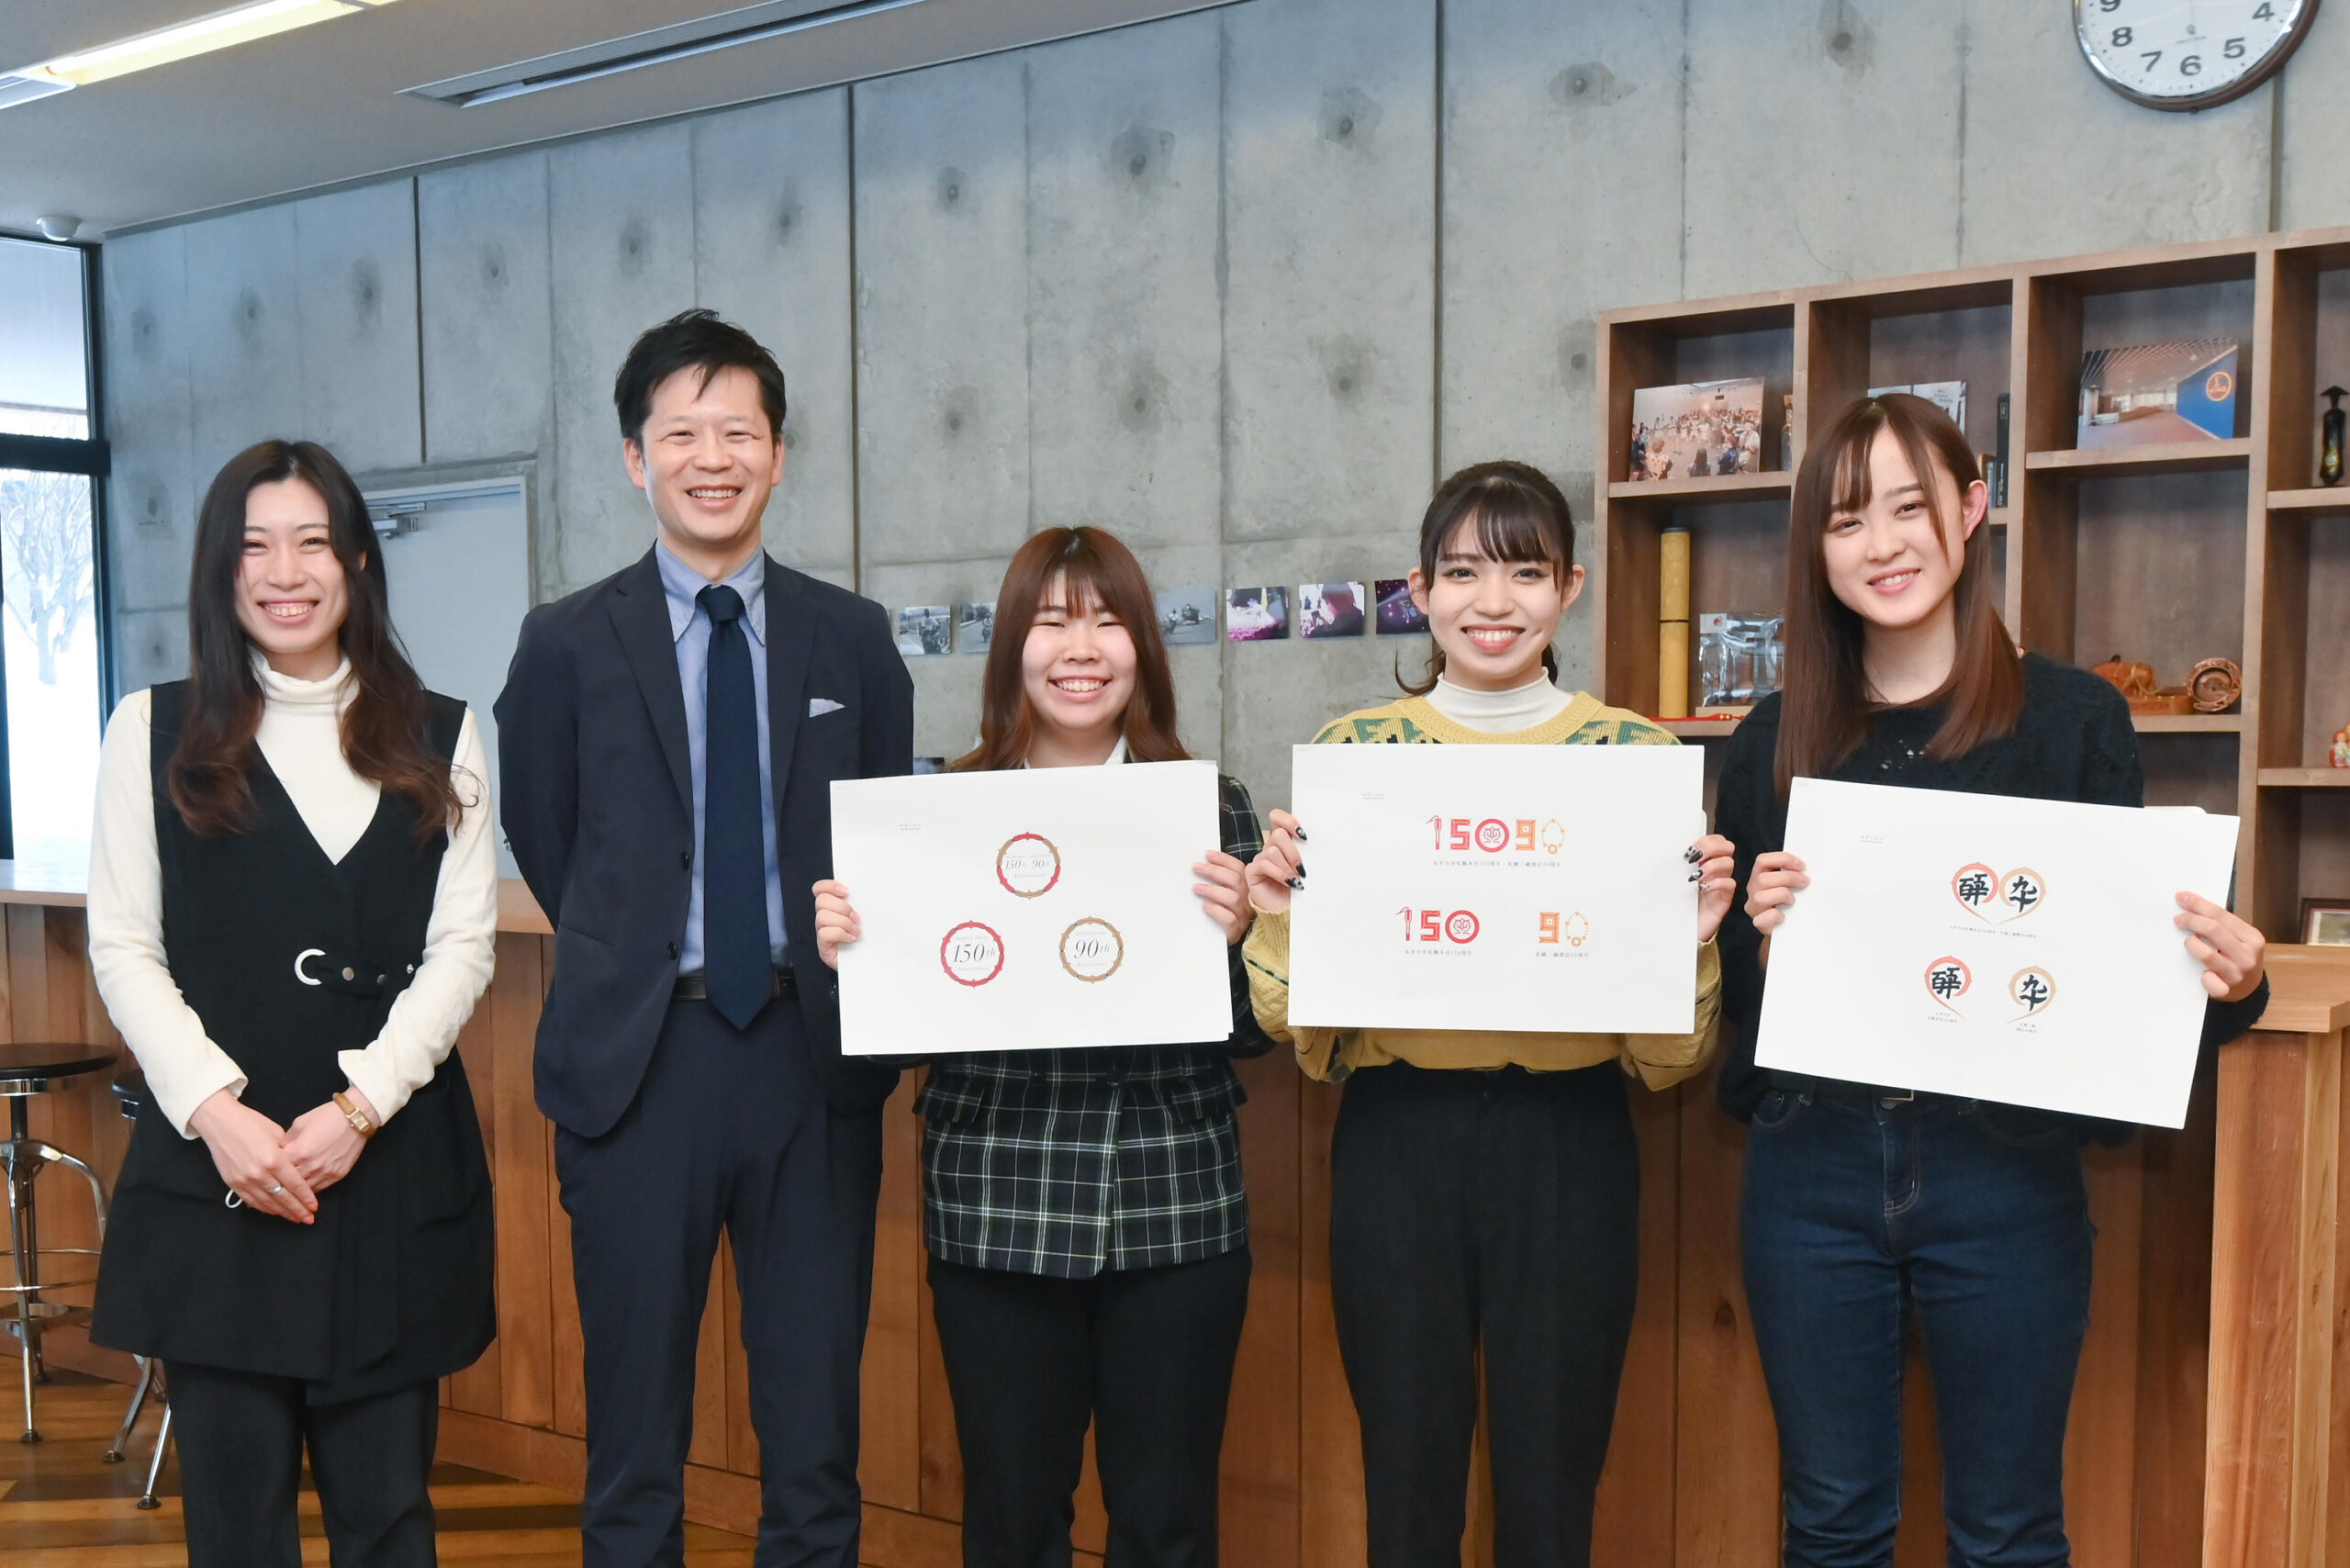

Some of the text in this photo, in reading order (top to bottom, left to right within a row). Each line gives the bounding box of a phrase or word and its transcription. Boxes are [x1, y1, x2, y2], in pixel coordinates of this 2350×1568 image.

[2252, 2, 2275, 23] 4
[2111, 26, 2133, 48] 8
[2223, 37, 2246, 59] 5
[2141, 50, 2163, 73] 7
[2179, 55, 2202, 76] 6
